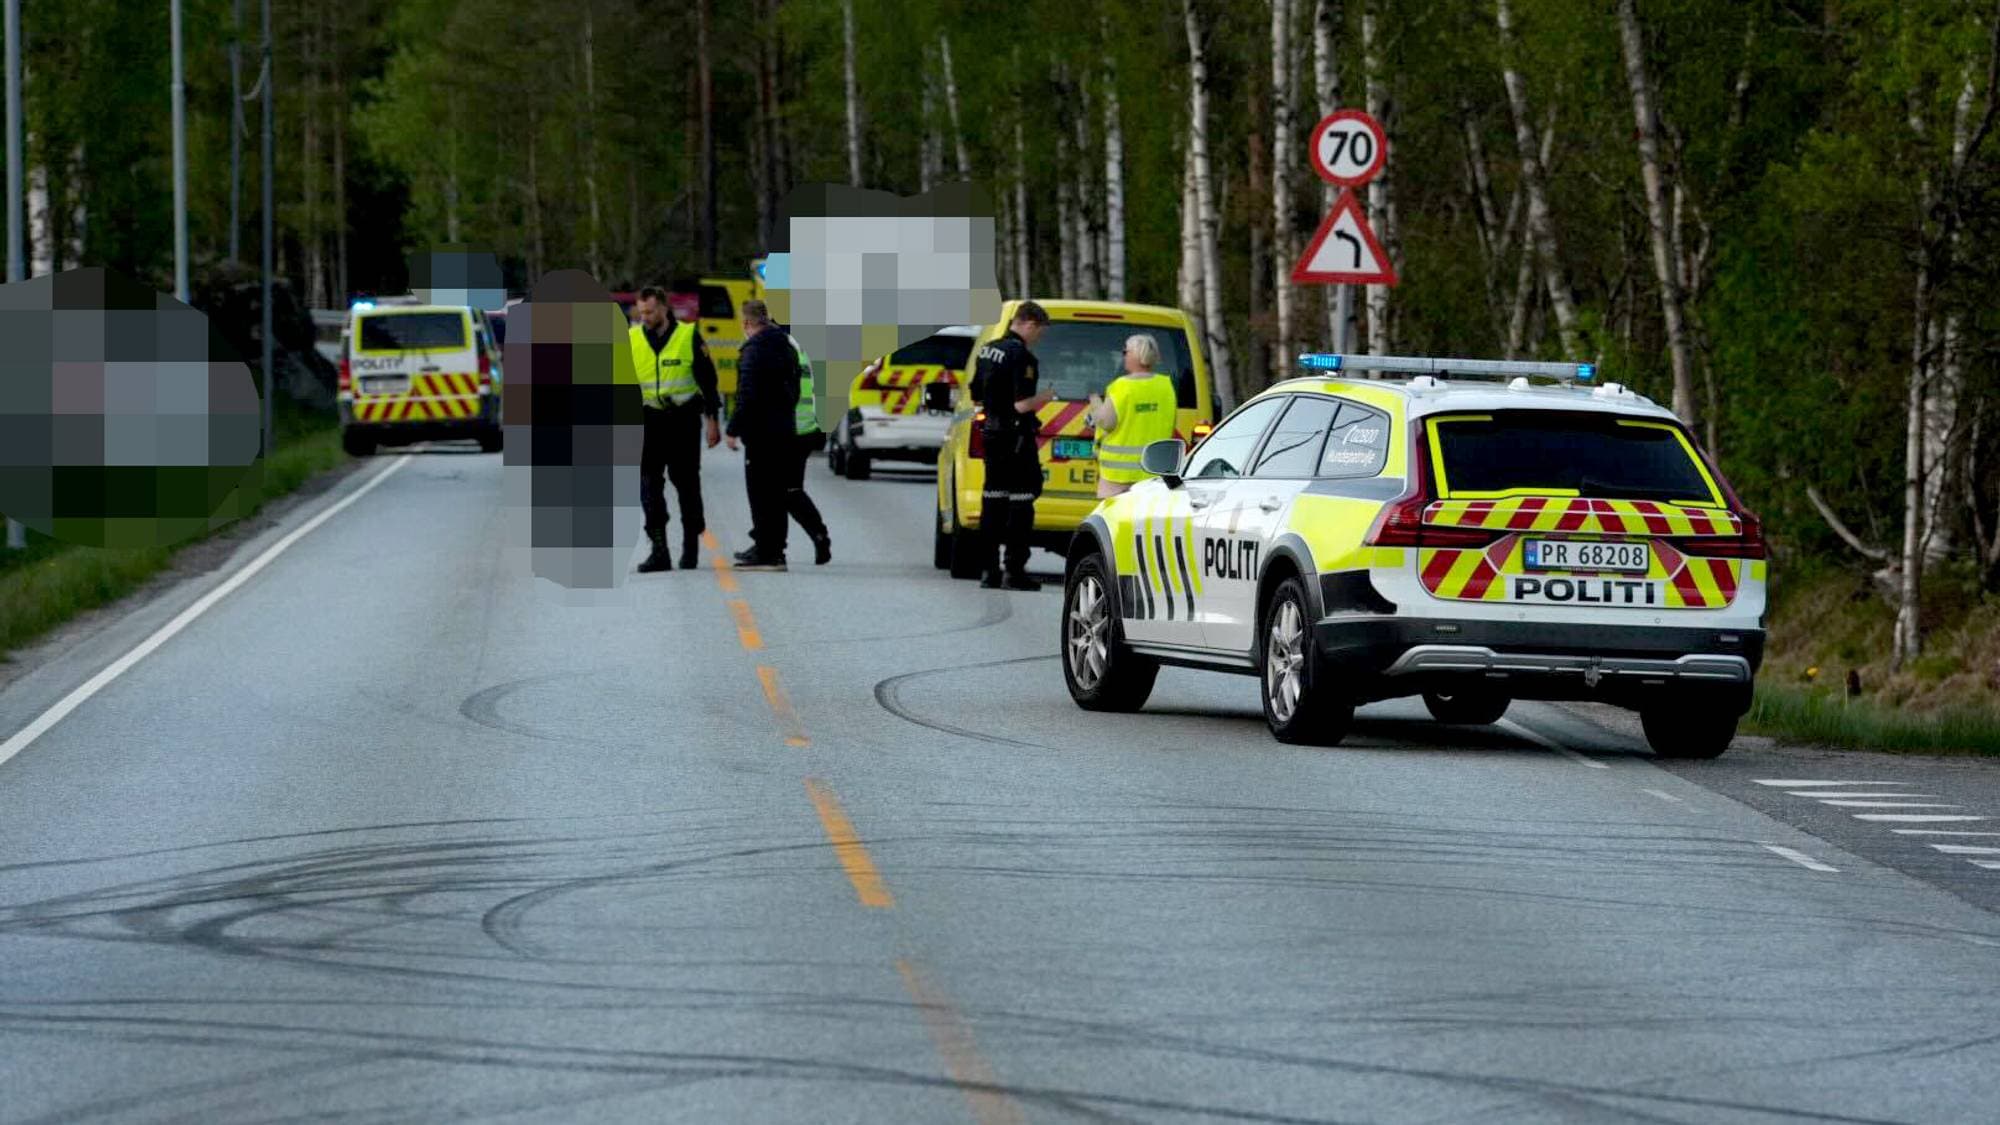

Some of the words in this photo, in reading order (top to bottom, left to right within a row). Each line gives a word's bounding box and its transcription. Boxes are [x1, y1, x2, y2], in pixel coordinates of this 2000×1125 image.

[1329, 131, 1372, 166] 70
[978, 346, 1006, 364] OLITI
[1064, 443, 1081, 454] PR
[1070, 469, 1098, 483] LE
[1204, 537, 1260, 581] POLITI
[1542, 544, 1567, 563] PR
[1579, 545, 1644, 566] 68208
[1515, 578, 1655, 604] POLITI
